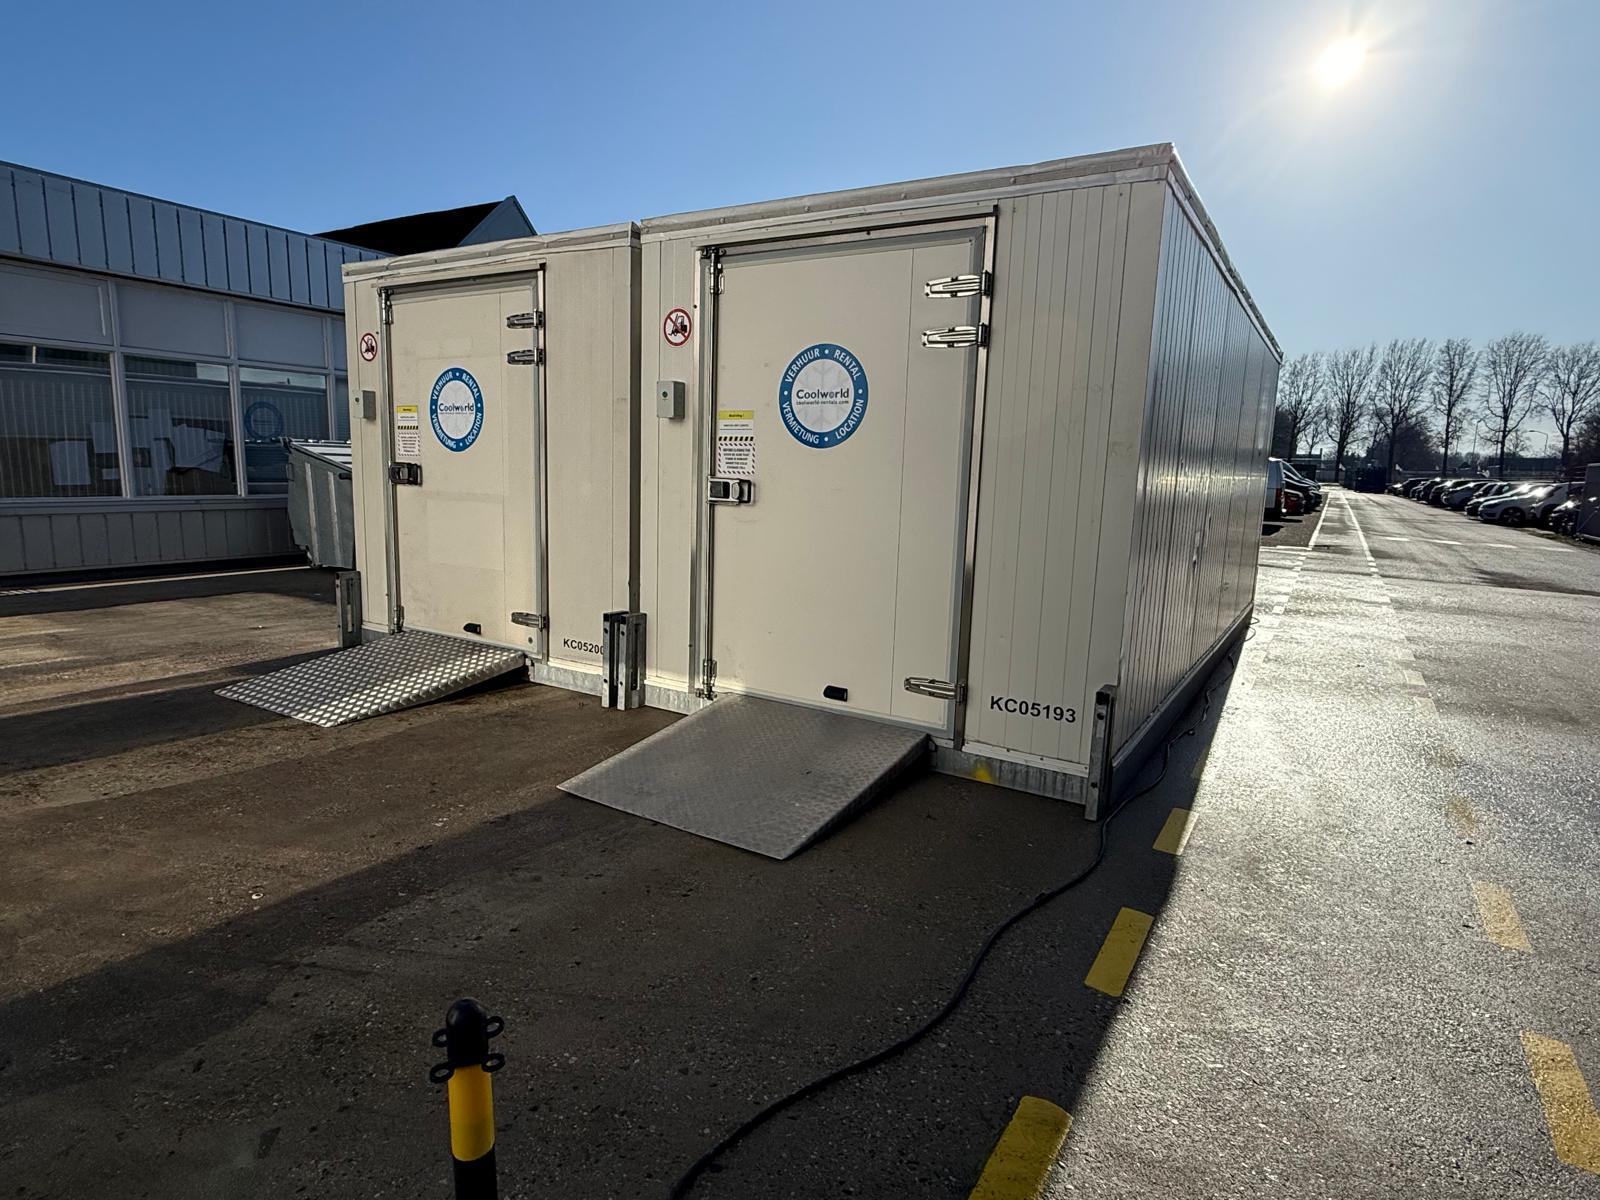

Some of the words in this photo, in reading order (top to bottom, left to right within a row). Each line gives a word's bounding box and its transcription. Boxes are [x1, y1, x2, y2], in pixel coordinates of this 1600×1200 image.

[785, 348, 820, 383] VERHUUR
[833, 349, 861, 381] RENTAL
[432, 371, 453, 400] VERHUUR
[462, 373, 480, 399] RENTAL
[796, 388, 849, 399] Coolworld
[432, 413, 456, 448] VERMIETUNG
[465, 412, 482, 445] LOCATION
[782, 401, 819, 444] VERMIETUNG
[835, 399, 864, 439] LOCATION
[990, 695, 1077, 723] KC05193
